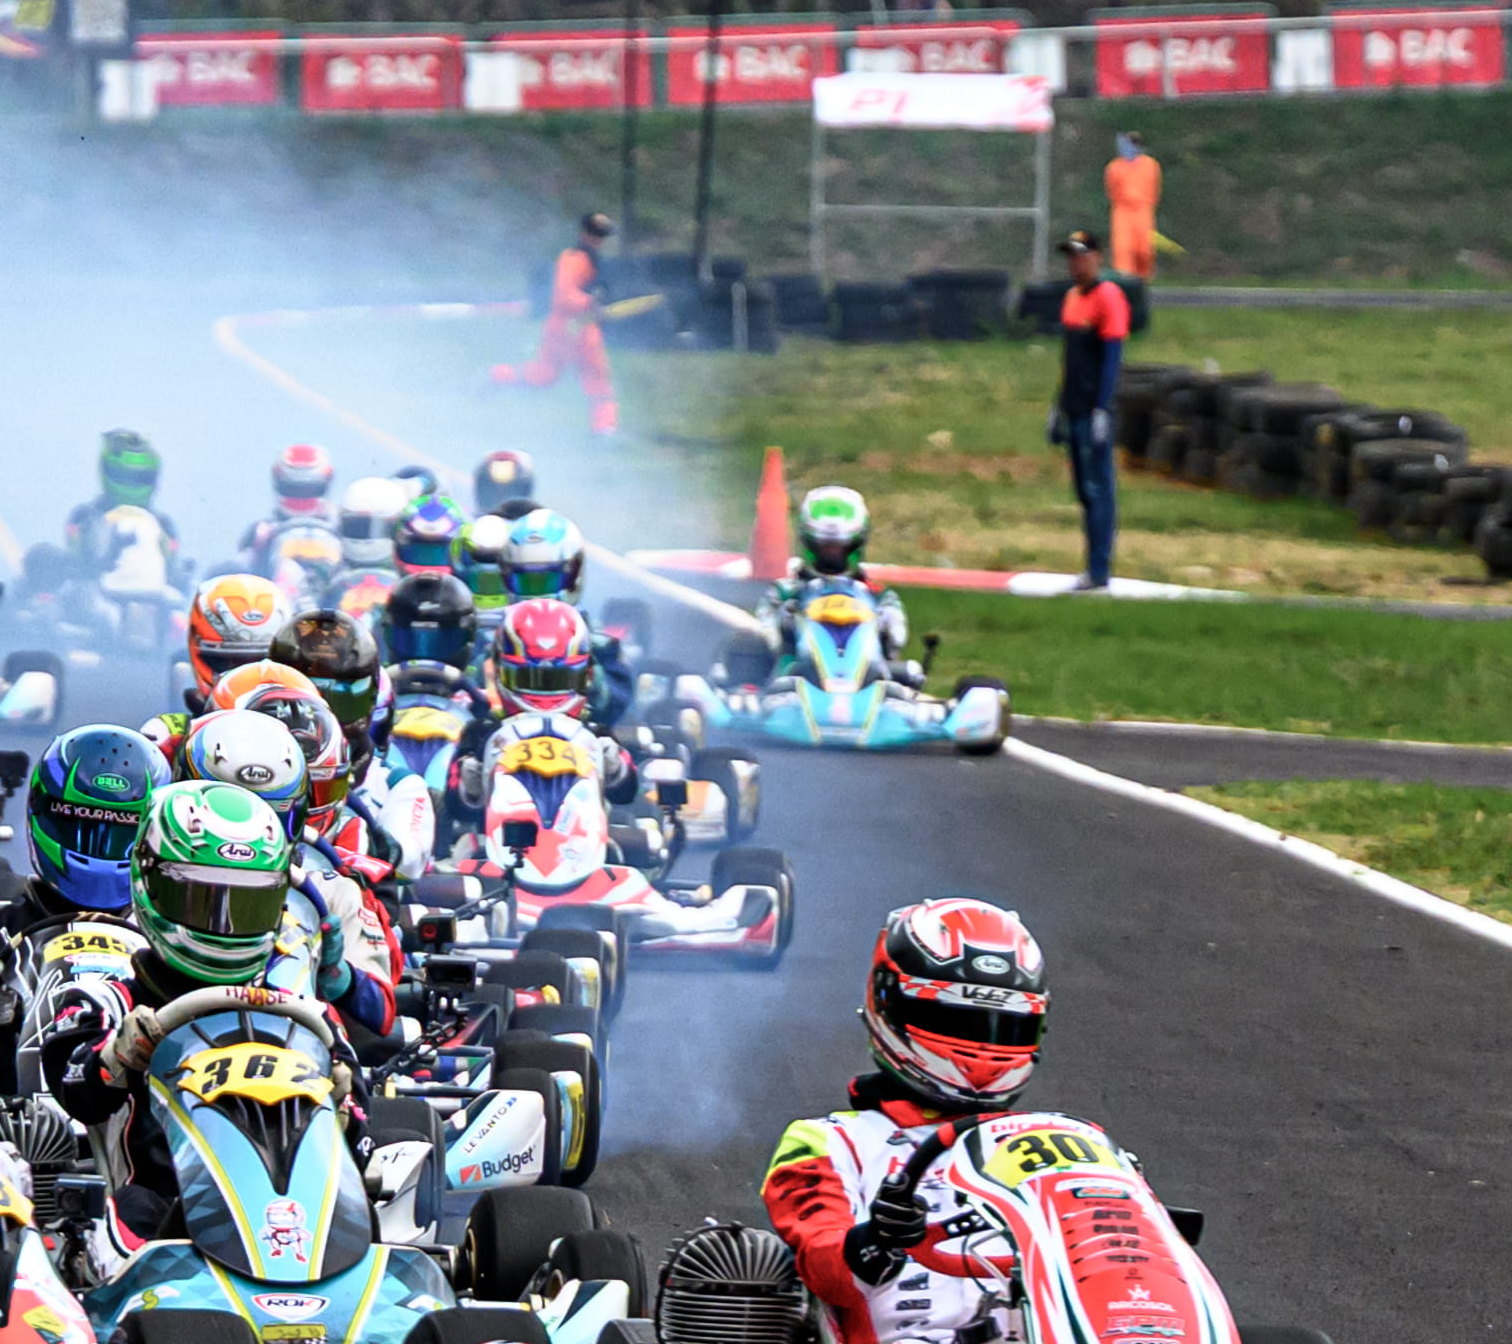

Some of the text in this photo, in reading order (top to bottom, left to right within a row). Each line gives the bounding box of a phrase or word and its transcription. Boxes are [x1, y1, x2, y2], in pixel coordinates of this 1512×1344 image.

[242, 766, 270, 779] Arai
[96, 776, 126, 788] BELL
[50, 802, 141, 824] LIVE YOUR PASSIO
[221, 844, 253, 857] Arai
[225, 985, 289, 1006] HAASE
[481, 1146, 535, 1179] Budget
